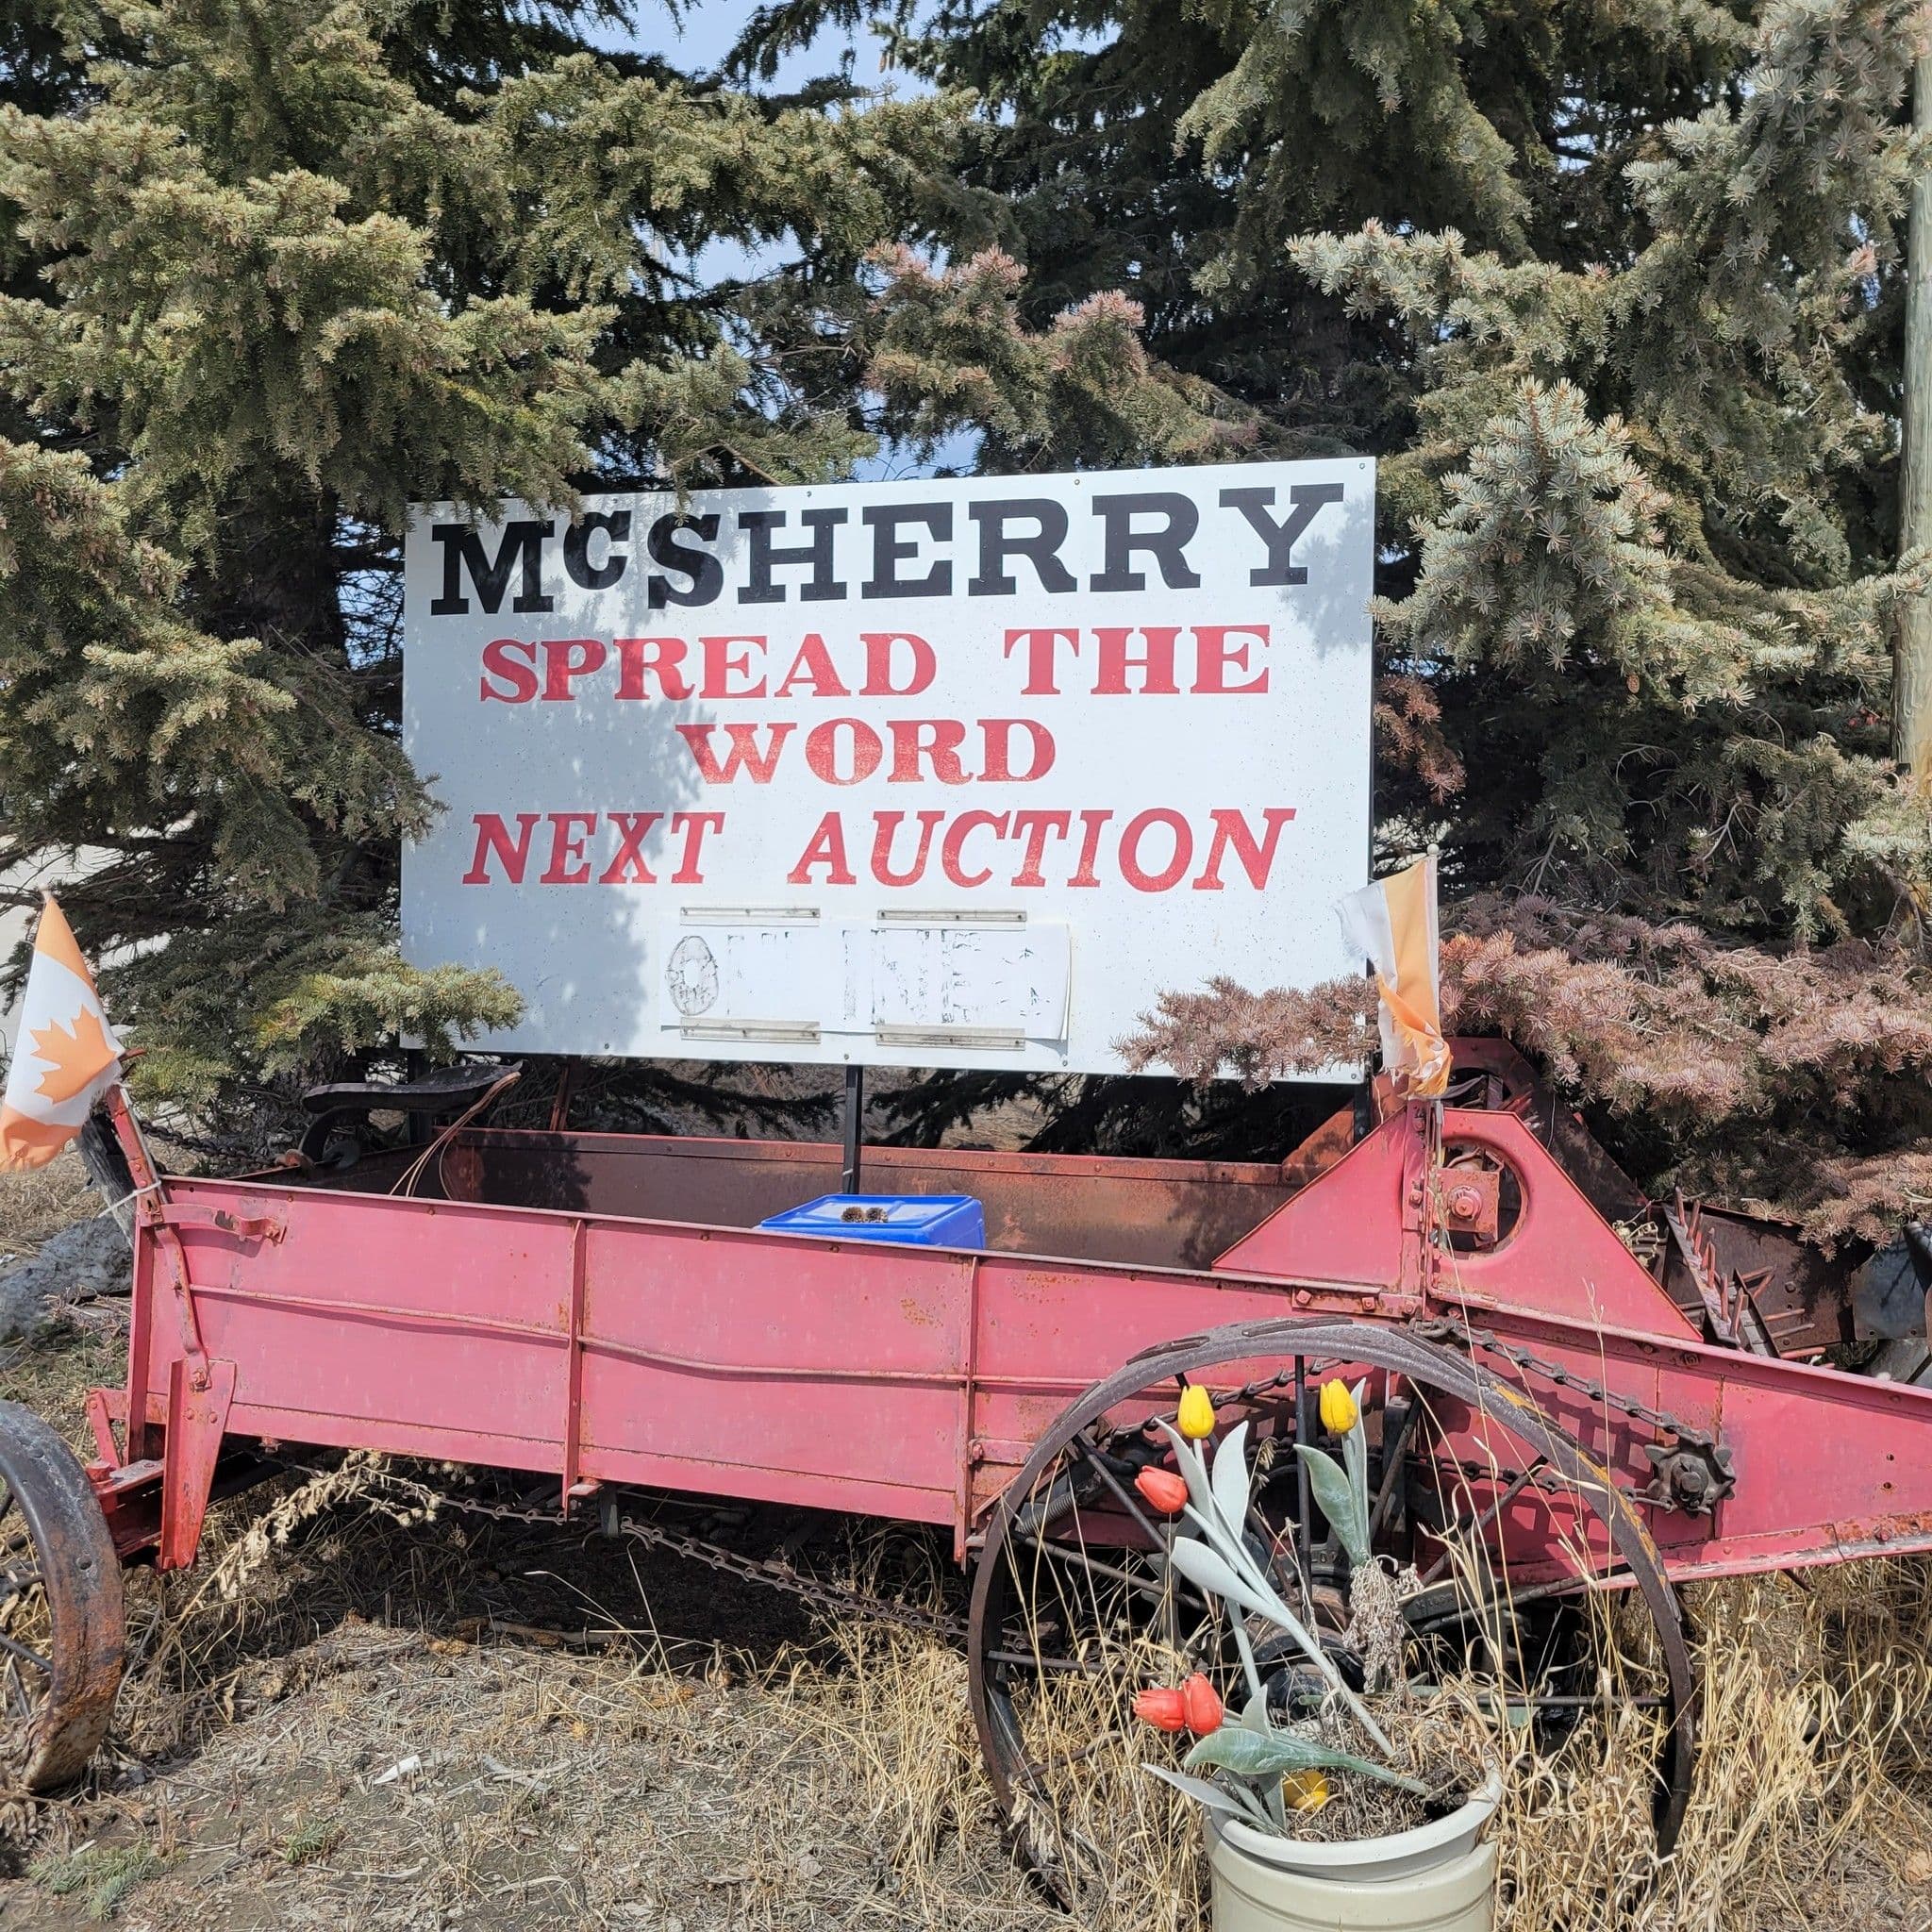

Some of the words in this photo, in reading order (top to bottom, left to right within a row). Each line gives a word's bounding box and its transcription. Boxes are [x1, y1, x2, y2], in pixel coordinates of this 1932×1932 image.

[480, 633, 936, 703] SPREAD
[1005, 625, 1270, 695] THE
[675, 718, 1056, 785] WORD
[463, 812, 724, 885] NEXT
[788, 808, 1295, 892] AUCTION
